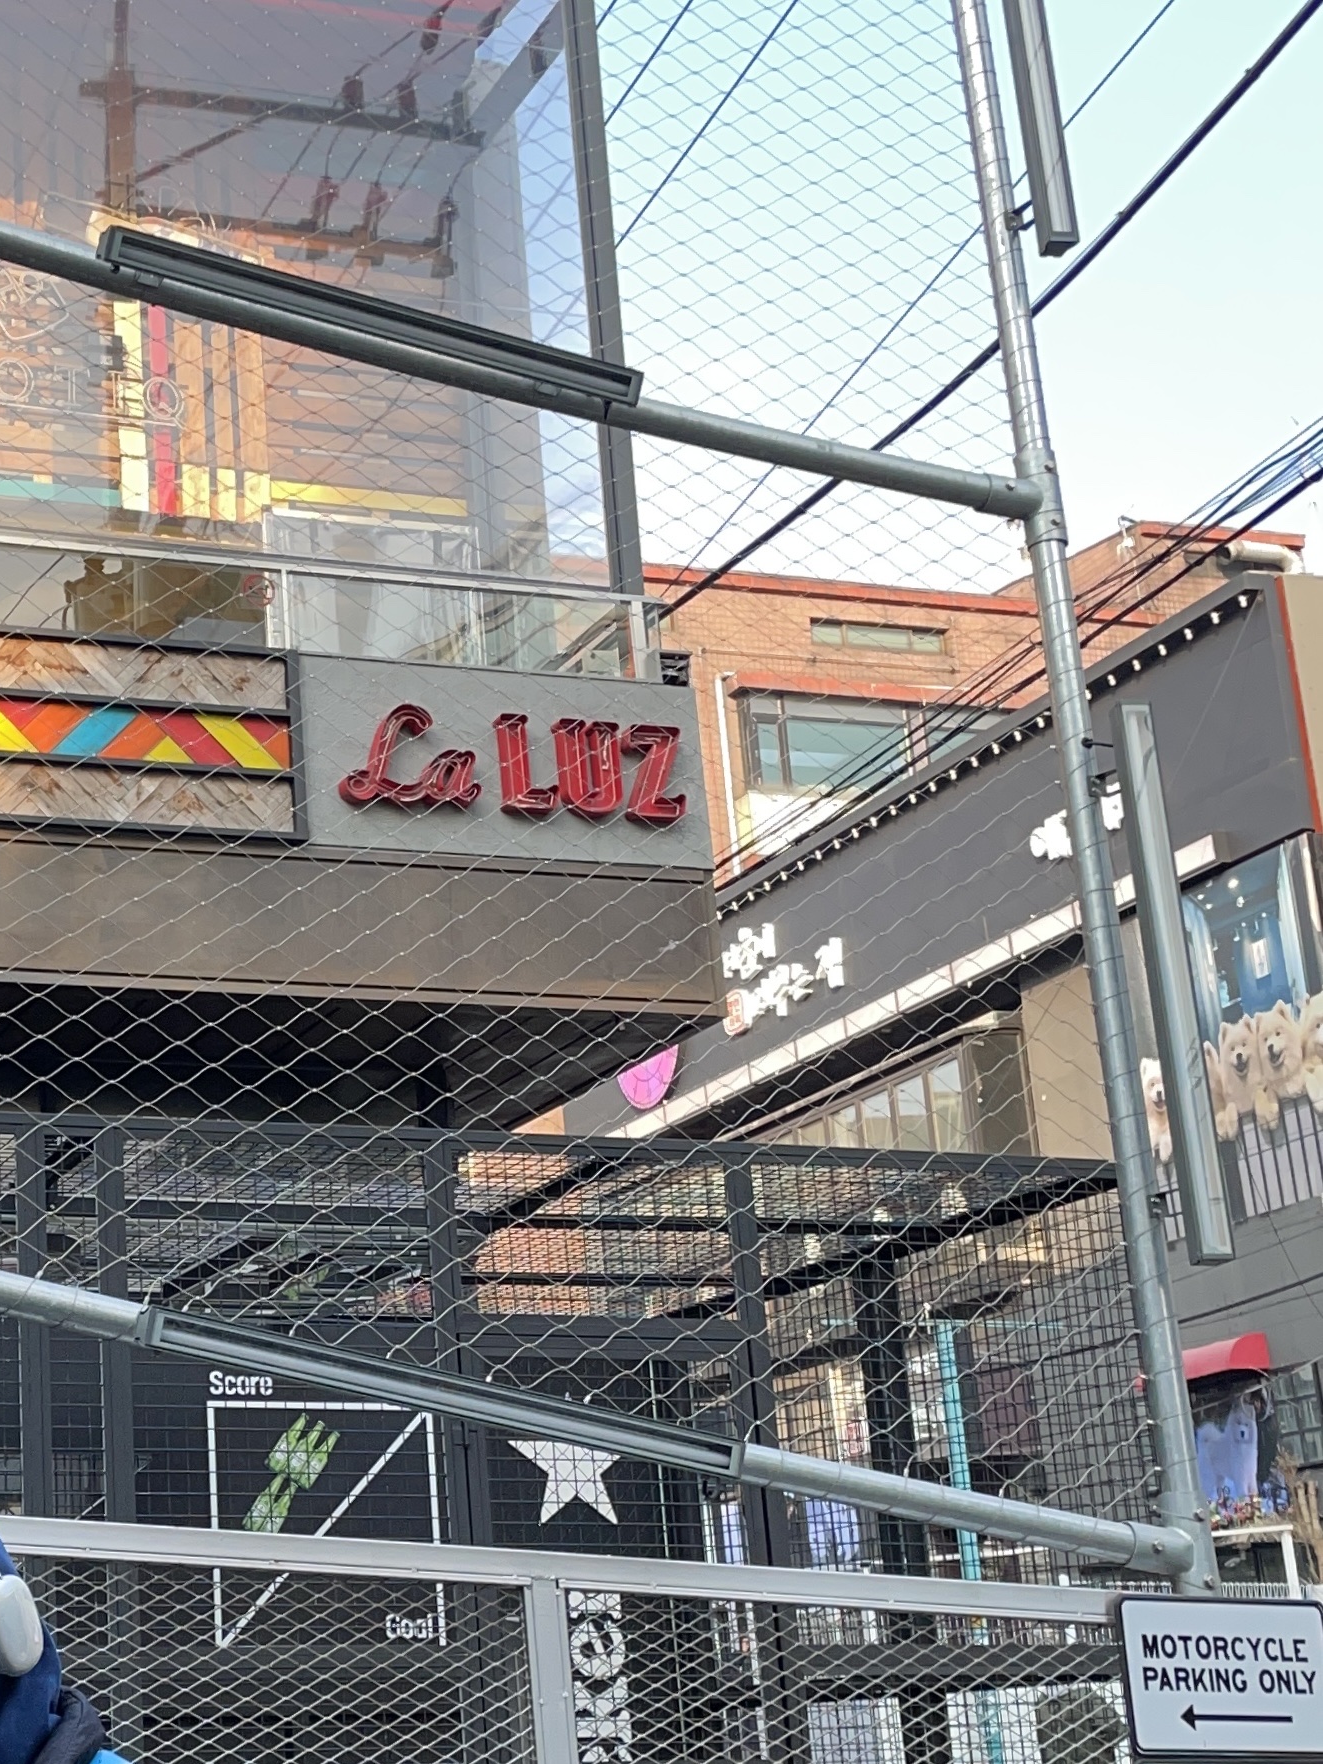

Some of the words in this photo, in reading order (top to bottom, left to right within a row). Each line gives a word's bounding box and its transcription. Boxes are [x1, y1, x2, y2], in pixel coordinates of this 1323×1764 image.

[338, 703, 483, 808] La
[492, 712, 688, 826] LUZ
[208, 1370, 274, 1396] Score
[1141, 1633, 1309, 1663] MOTORCYCLE
[1142, 1666, 1248, 1693] PARKING
[1259, 1669, 1317, 1695] ONLY
